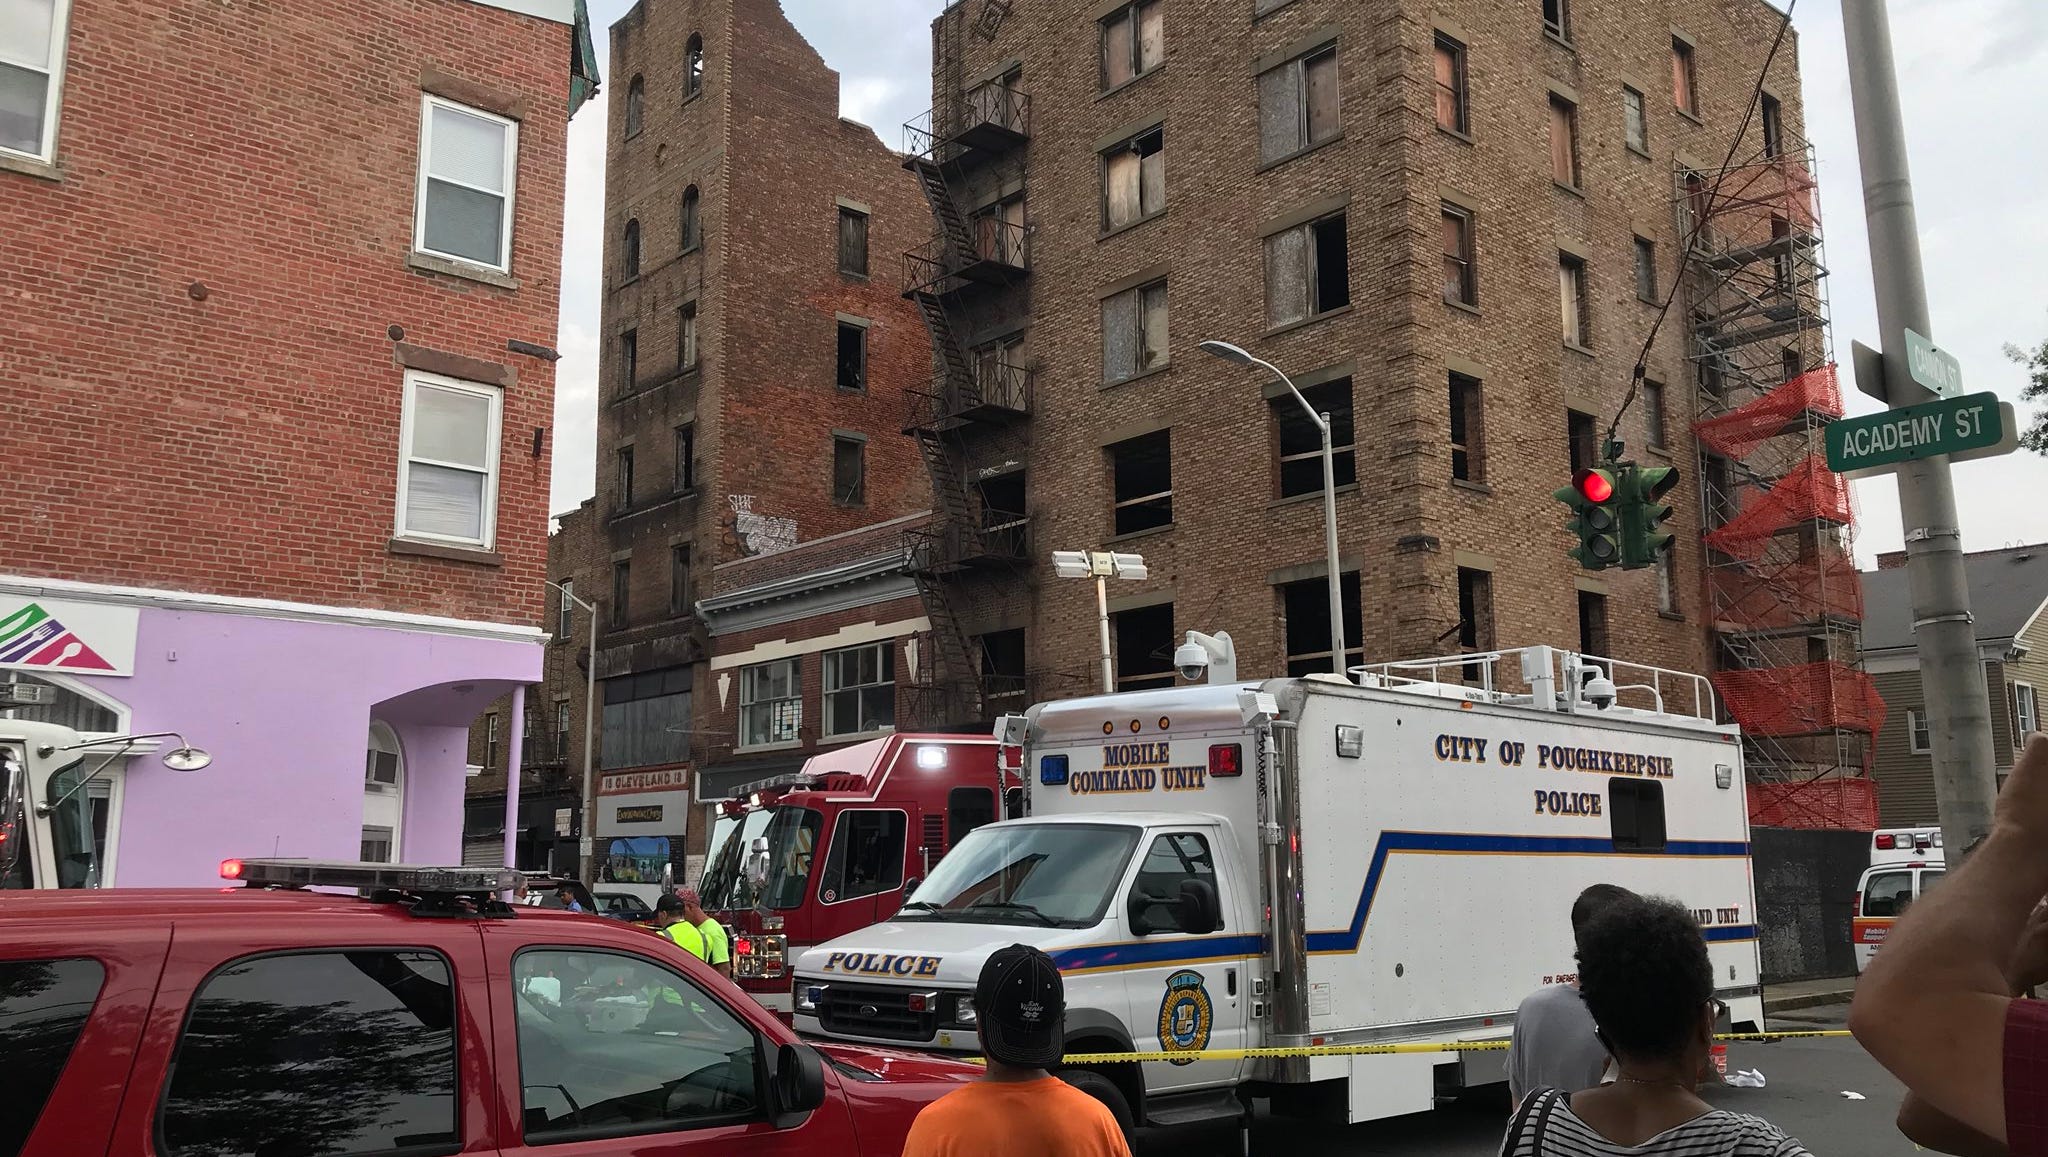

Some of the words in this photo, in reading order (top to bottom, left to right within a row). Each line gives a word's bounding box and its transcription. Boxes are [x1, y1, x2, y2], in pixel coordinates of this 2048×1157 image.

[1843, 413, 1943, 459] ACADEMY
[1955, 406, 1983, 438] ST
[1103, 742, 1169, 769] MOBILE
[1434, 733, 1488, 763] CITY
[1498, 740, 1525, 766] OF
[1537, 744, 1674, 779] POUGHKEEPSIE
[1070, 767, 1157, 795] COMMAND
[1161, 765, 1206, 792] UNIT
[1534, 789, 1601, 817] POLICE
[1717, 908, 1739, 924] UNIT
[823, 952, 943, 979] POLICE
[1542, 975, 1553, 985] FOR
